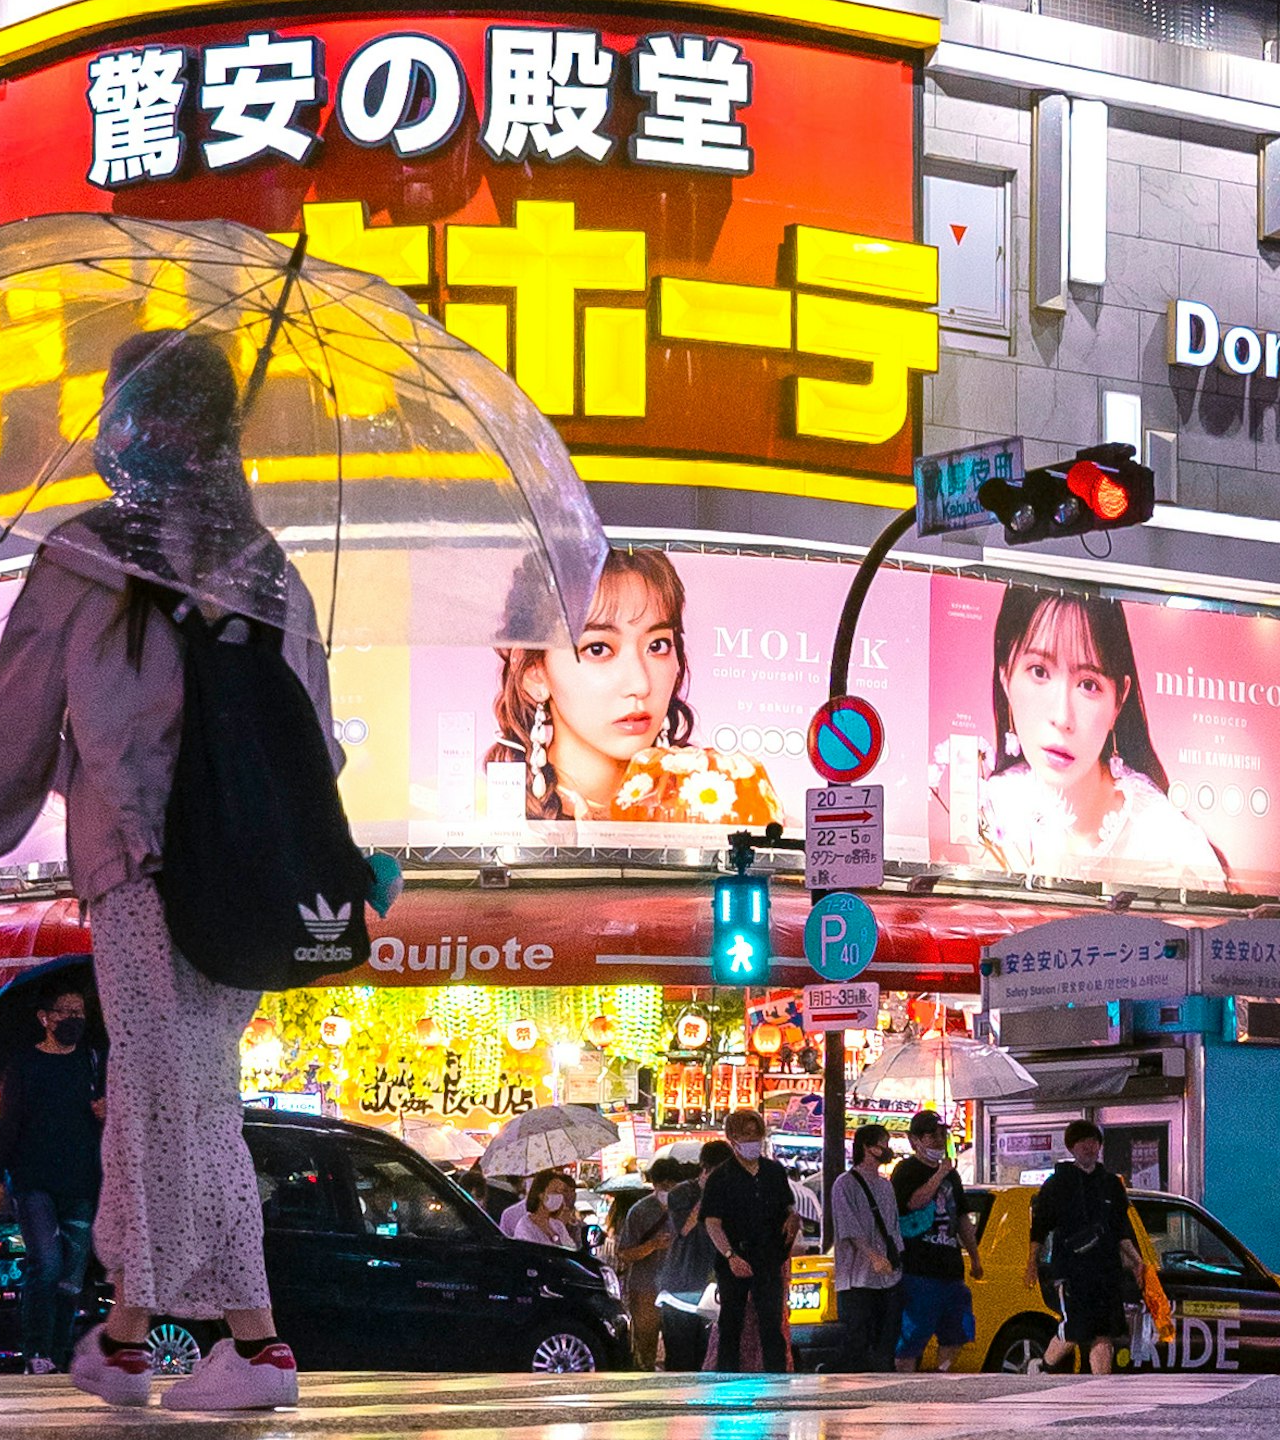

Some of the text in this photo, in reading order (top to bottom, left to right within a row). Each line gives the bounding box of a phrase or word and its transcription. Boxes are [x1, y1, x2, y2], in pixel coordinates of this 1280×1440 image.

[86, 26, 754, 186] 驚安の殿堂
[713, 626, 889, 670] MOLK
[713, 665, 746, 679] color
[751, 666, 804, 686] yourself
[808, 671, 821, 684] to
[856, 678, 889, 690] mood
[738, 699, 753, 713] by
[1192, 713, 1248, 728] PRODUCED
[1179, 748, 1261, 771] MIKI KAWANISHI
[293, 943, 352, 962] adidas
[821, 915, 847, 967] P
[369, 935, 554, 981] Quijote
[841, 943, 860, 966] 40
[1005, 940, 1166, 975] 安全安心ステーション
[683, 1021, 701, 1039] 祭
